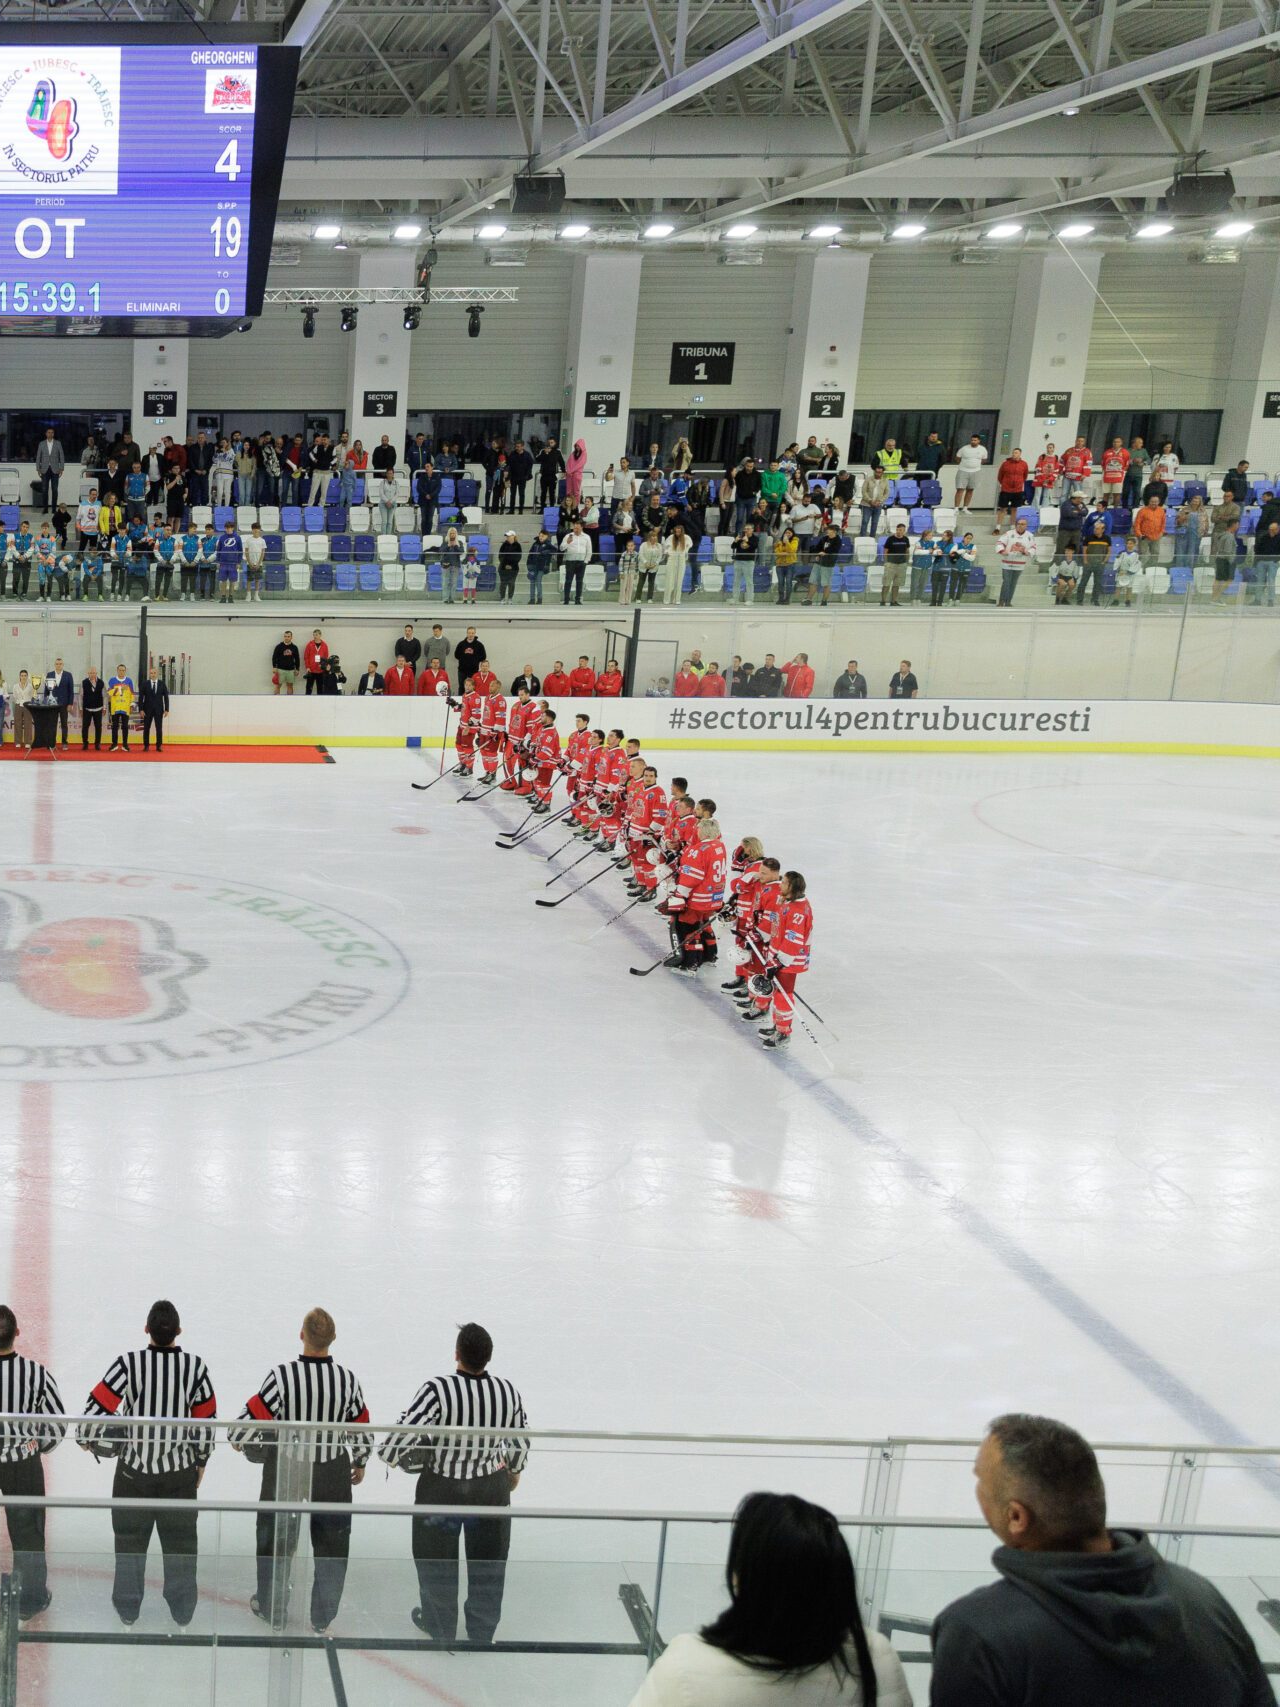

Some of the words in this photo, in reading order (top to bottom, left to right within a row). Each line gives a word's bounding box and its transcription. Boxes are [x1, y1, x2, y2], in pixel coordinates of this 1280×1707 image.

[191, 51, 254, 65] GHEORGHENI
[219, 125, 242, 133] SCOR
[11, 157, 68, 183] SECTORUL
[67, 144, 101, 179] PATRU
[214, 139, 241, 181] 4
[35, 198, 66, 206] PERIOD
[14, 217, 86, 259] OT
[210, 216, 241, 258] 19
[126, 302, 181, 312] ELIMINARI
[214, 287, 230, 315] 0
[679, 347, 728, 357] TRIBUNA
[694, 362, 708, 380] 1
[156, 403, 164, 414] 3
[375, 403, 384, 415] 3
[597, 403, 607, 415] 2
[822, 404, 832, 416] 2
[1047, 404, 1057, 416] 1
[668, 704, 1091, 737] #sectorul4pentrubucuresti
[792, 913, 805, 926] 27
[194, 980, 375, 1053] PATRU
